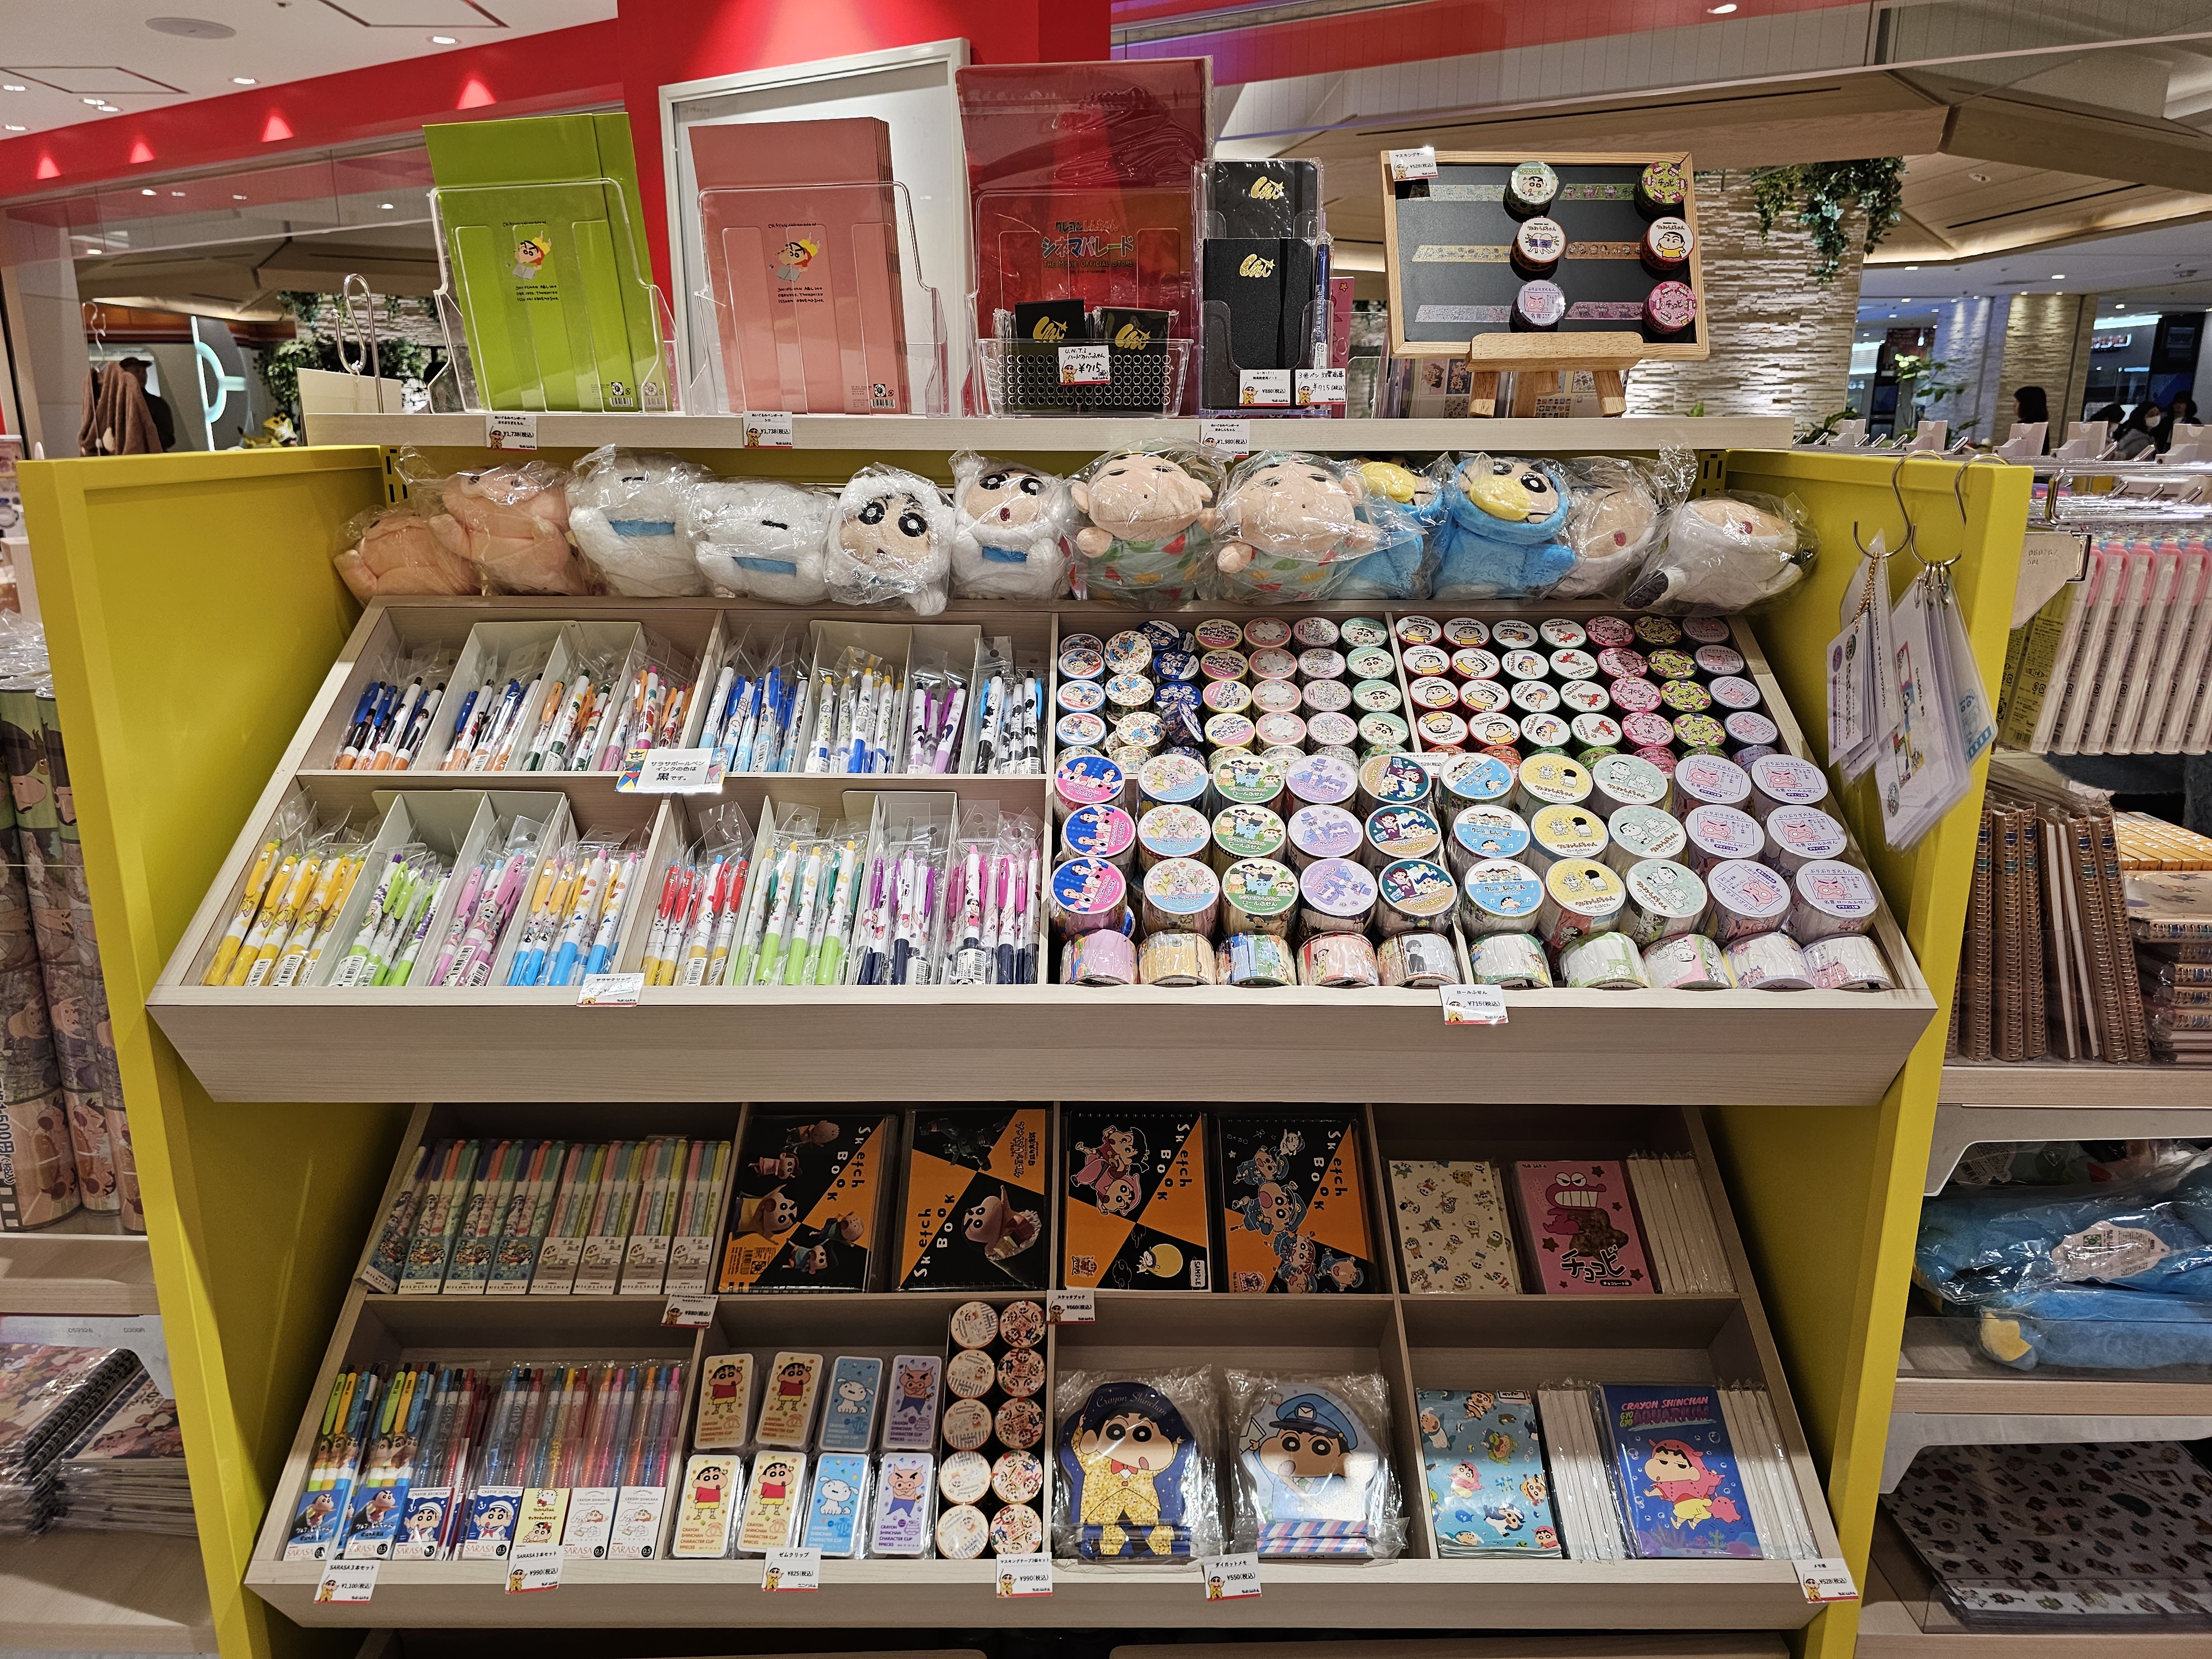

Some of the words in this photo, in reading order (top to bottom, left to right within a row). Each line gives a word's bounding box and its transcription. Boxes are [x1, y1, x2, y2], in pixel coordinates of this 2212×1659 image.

[1658, 178, 1675, 187] チョコビ
[1055, 219, 1119, 233] クレヨンしんちゃん
[1041, 235, 1134, 258] シネマパレード
[1666, 300, 1683, 310] チョコビ
[1350, 620, 1380, 629] クレヨンしんちゃん
[1351, 649, 1379, 660] クレヨンしんちゃん
[1358, 684, 1387, 693] クレヨンしんちゃん
[1373, 714, 1402, 729] クレヨンしんちゃん
[1695, 759, 1737, 772] ぶりぶりざえもん
[656, 773, 686, 781] 黒です。
[1541, 791, 1567, 800] ロールふせん
[1613, 789, 1638, 800] ロールふせん
[1703, 785, 1734, 797] ロールふせん
[1703, 811, 1746, 821] ぶりぶりざえもん
[1471, 826, 1512, 837] クレヨンしんちゃん
[1228, 841, 1262, 850] ロールふせん
[1234, 837, 1266, 846] クレヨンしんちゃん
[1394, 842, 1428, 850] ロールふせん
[1396, 837, 1428, 846] クレヨンしんちゃん
[1717, 840, 1750, 848] ロールふせん
[1413, 891, 1445, 902] クレヨンしんちゃん
[1413, 897, 1446, 909] ロールふせん
[1561, 1244, 1626, 1284] チョコビ
[1097, 1395, 1127, 1407] Crayon
[1129, 1392, 1167, 1416] Shinchan
[1621, 1400, 1658, 1411] CRAYON
[1661, 1396, 1709, 1408] SHINCHAN
[1620, 1411, 1634, 1419] GYO
[1633, 1405, 1710, 1425] AQUARIUM
[1620, 1418, 1633, 1428] GYO
[287, 1548, 313, 1557] SARASA
[347, 1545, 375, 1553] SARASA
[529, 1567, 558, 1576] ¥990(税込)
